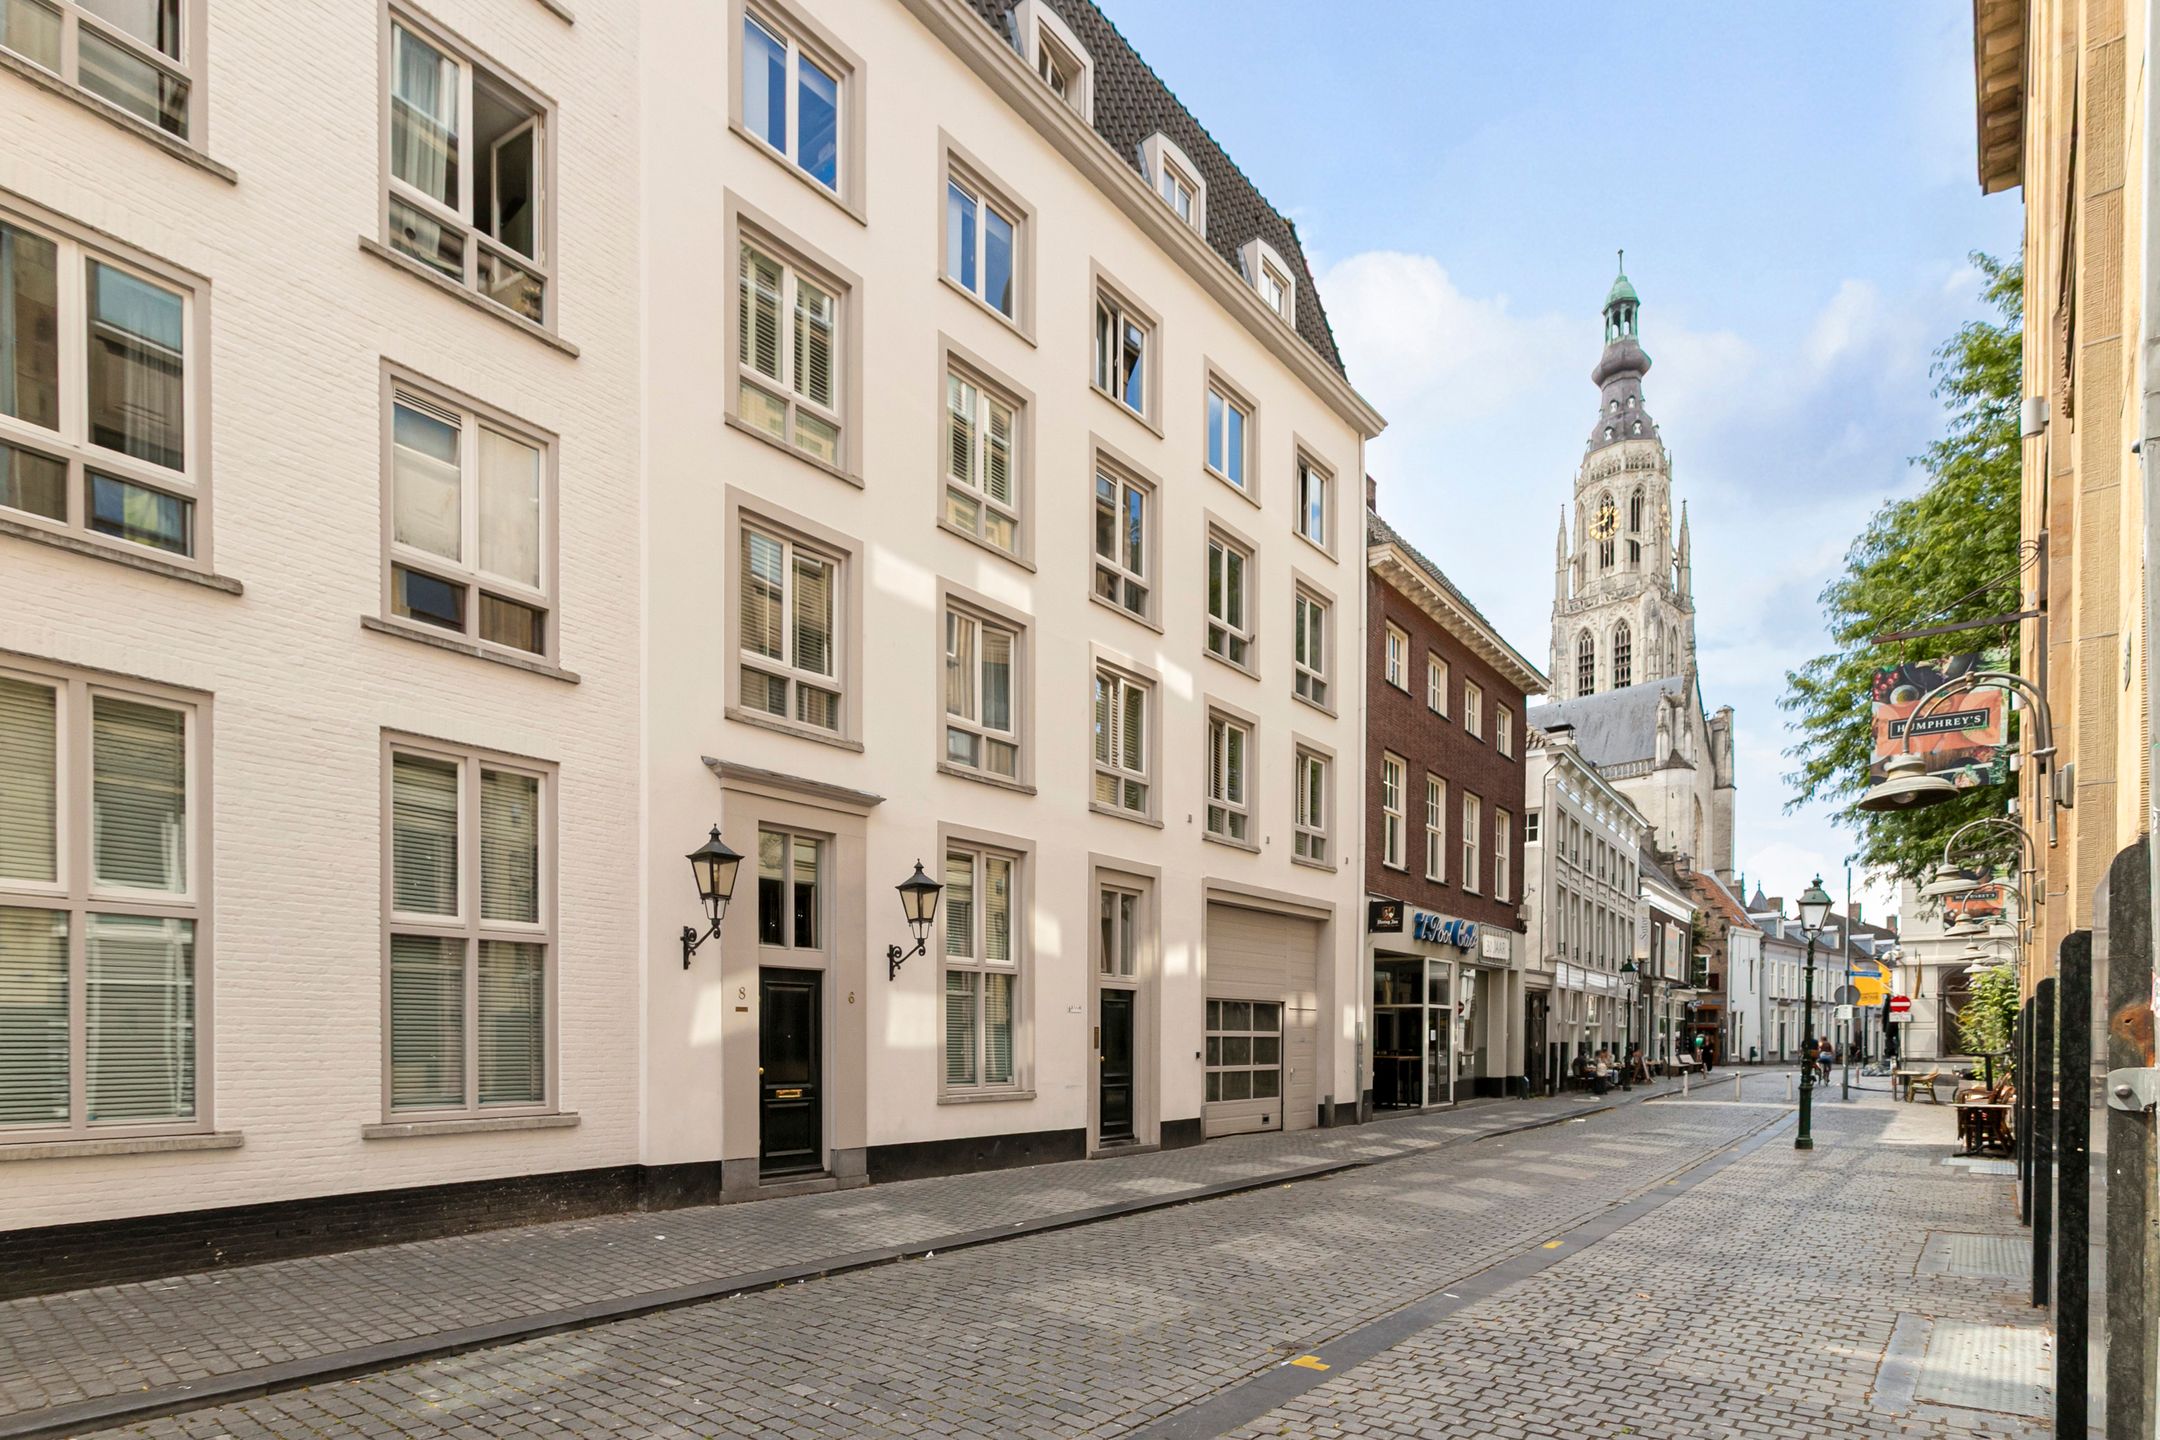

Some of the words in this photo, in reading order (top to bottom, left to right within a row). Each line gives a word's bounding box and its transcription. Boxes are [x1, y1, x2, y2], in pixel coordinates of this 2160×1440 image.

[1428, 915, 1453, 944] Pool
[738, 986, 746, 1000] 8
[848, 991, 855, 1004] 6
